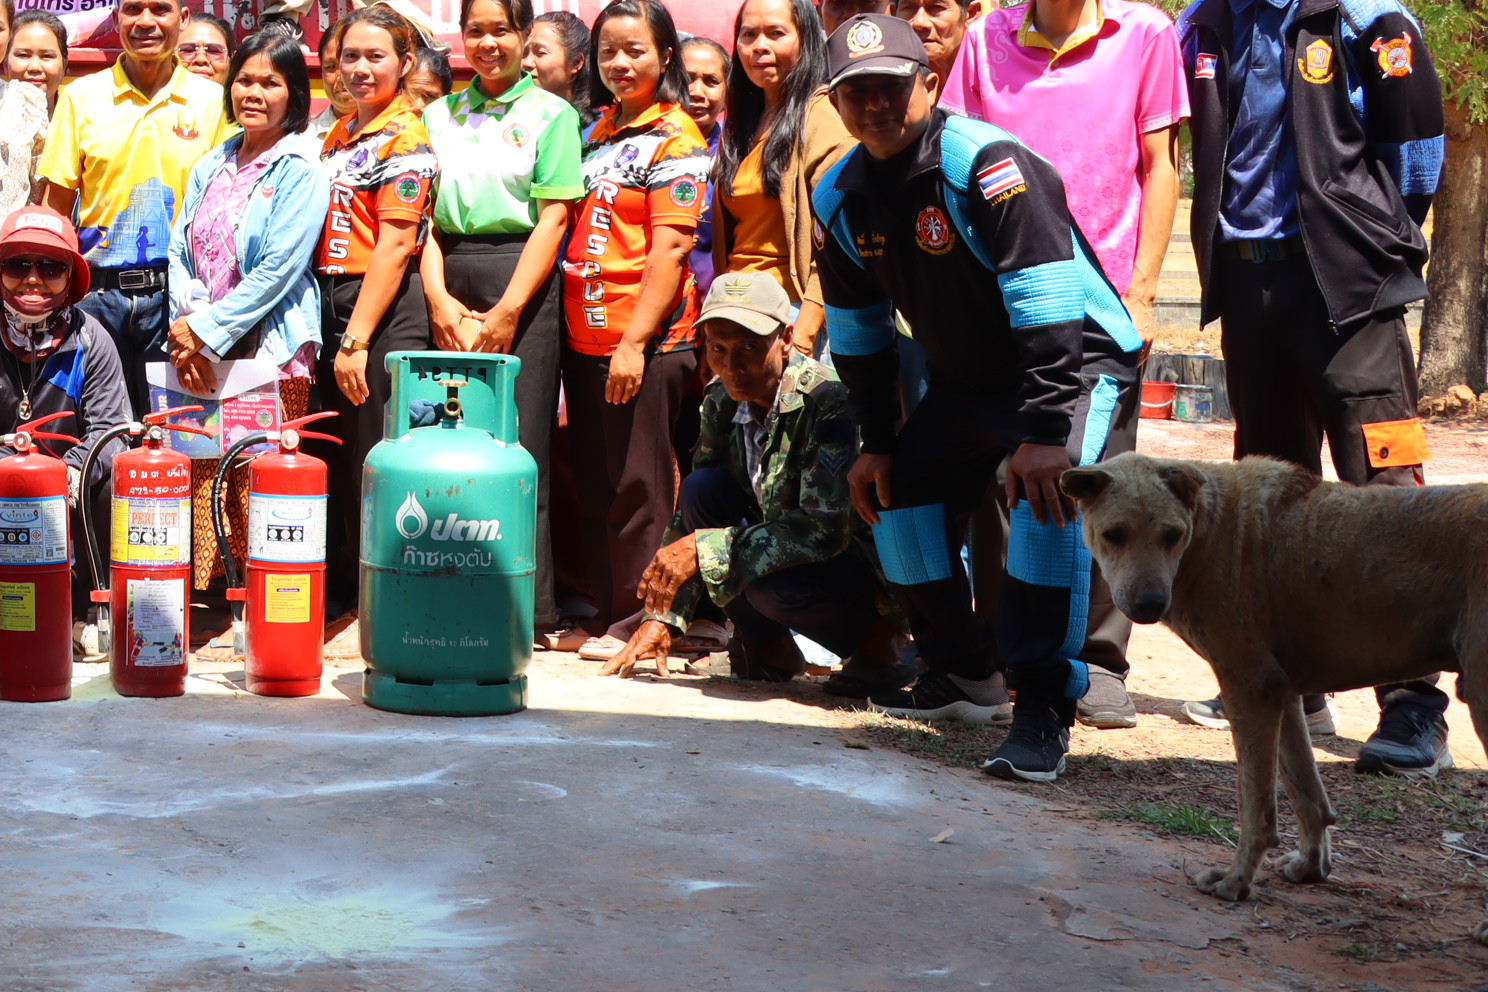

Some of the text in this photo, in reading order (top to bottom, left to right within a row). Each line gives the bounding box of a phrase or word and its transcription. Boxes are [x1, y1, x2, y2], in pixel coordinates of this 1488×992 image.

[430, 512, 503, 541] ปตท.
[403, 544, 493, 567] ก๊าซหงต้ม
